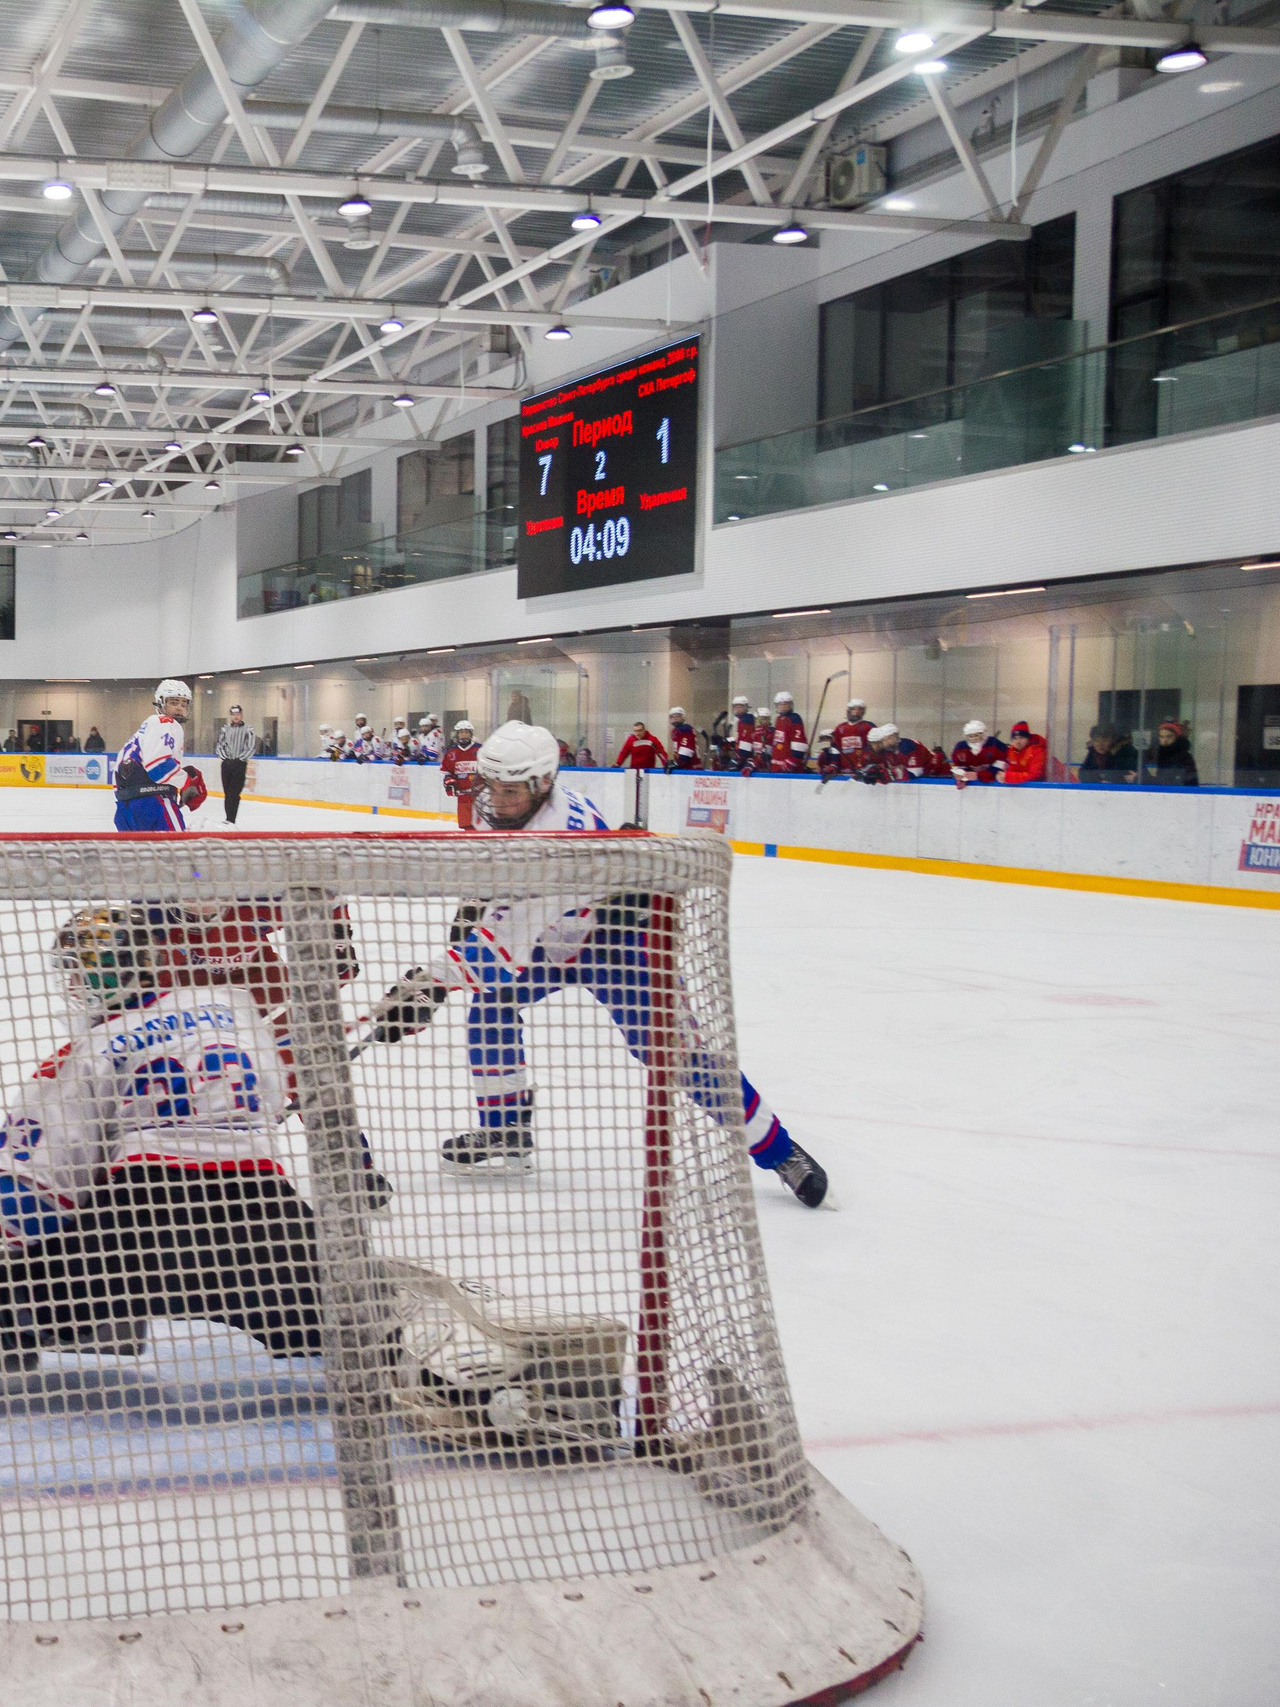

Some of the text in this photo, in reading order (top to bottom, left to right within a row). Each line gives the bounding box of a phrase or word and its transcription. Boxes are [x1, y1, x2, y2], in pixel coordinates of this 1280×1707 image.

[638, 381, 655, 398] СКА
[572, 410, 633, 447] Период
[656, 417, 670, 464] 1
[538, 454, 553, 496] 7
[594, 450, 607, 481] 2
[576, 486, 625, 518] Время
[639, 487, 687, 510] Удаления
[570, 516, 631, 565] 04:09
